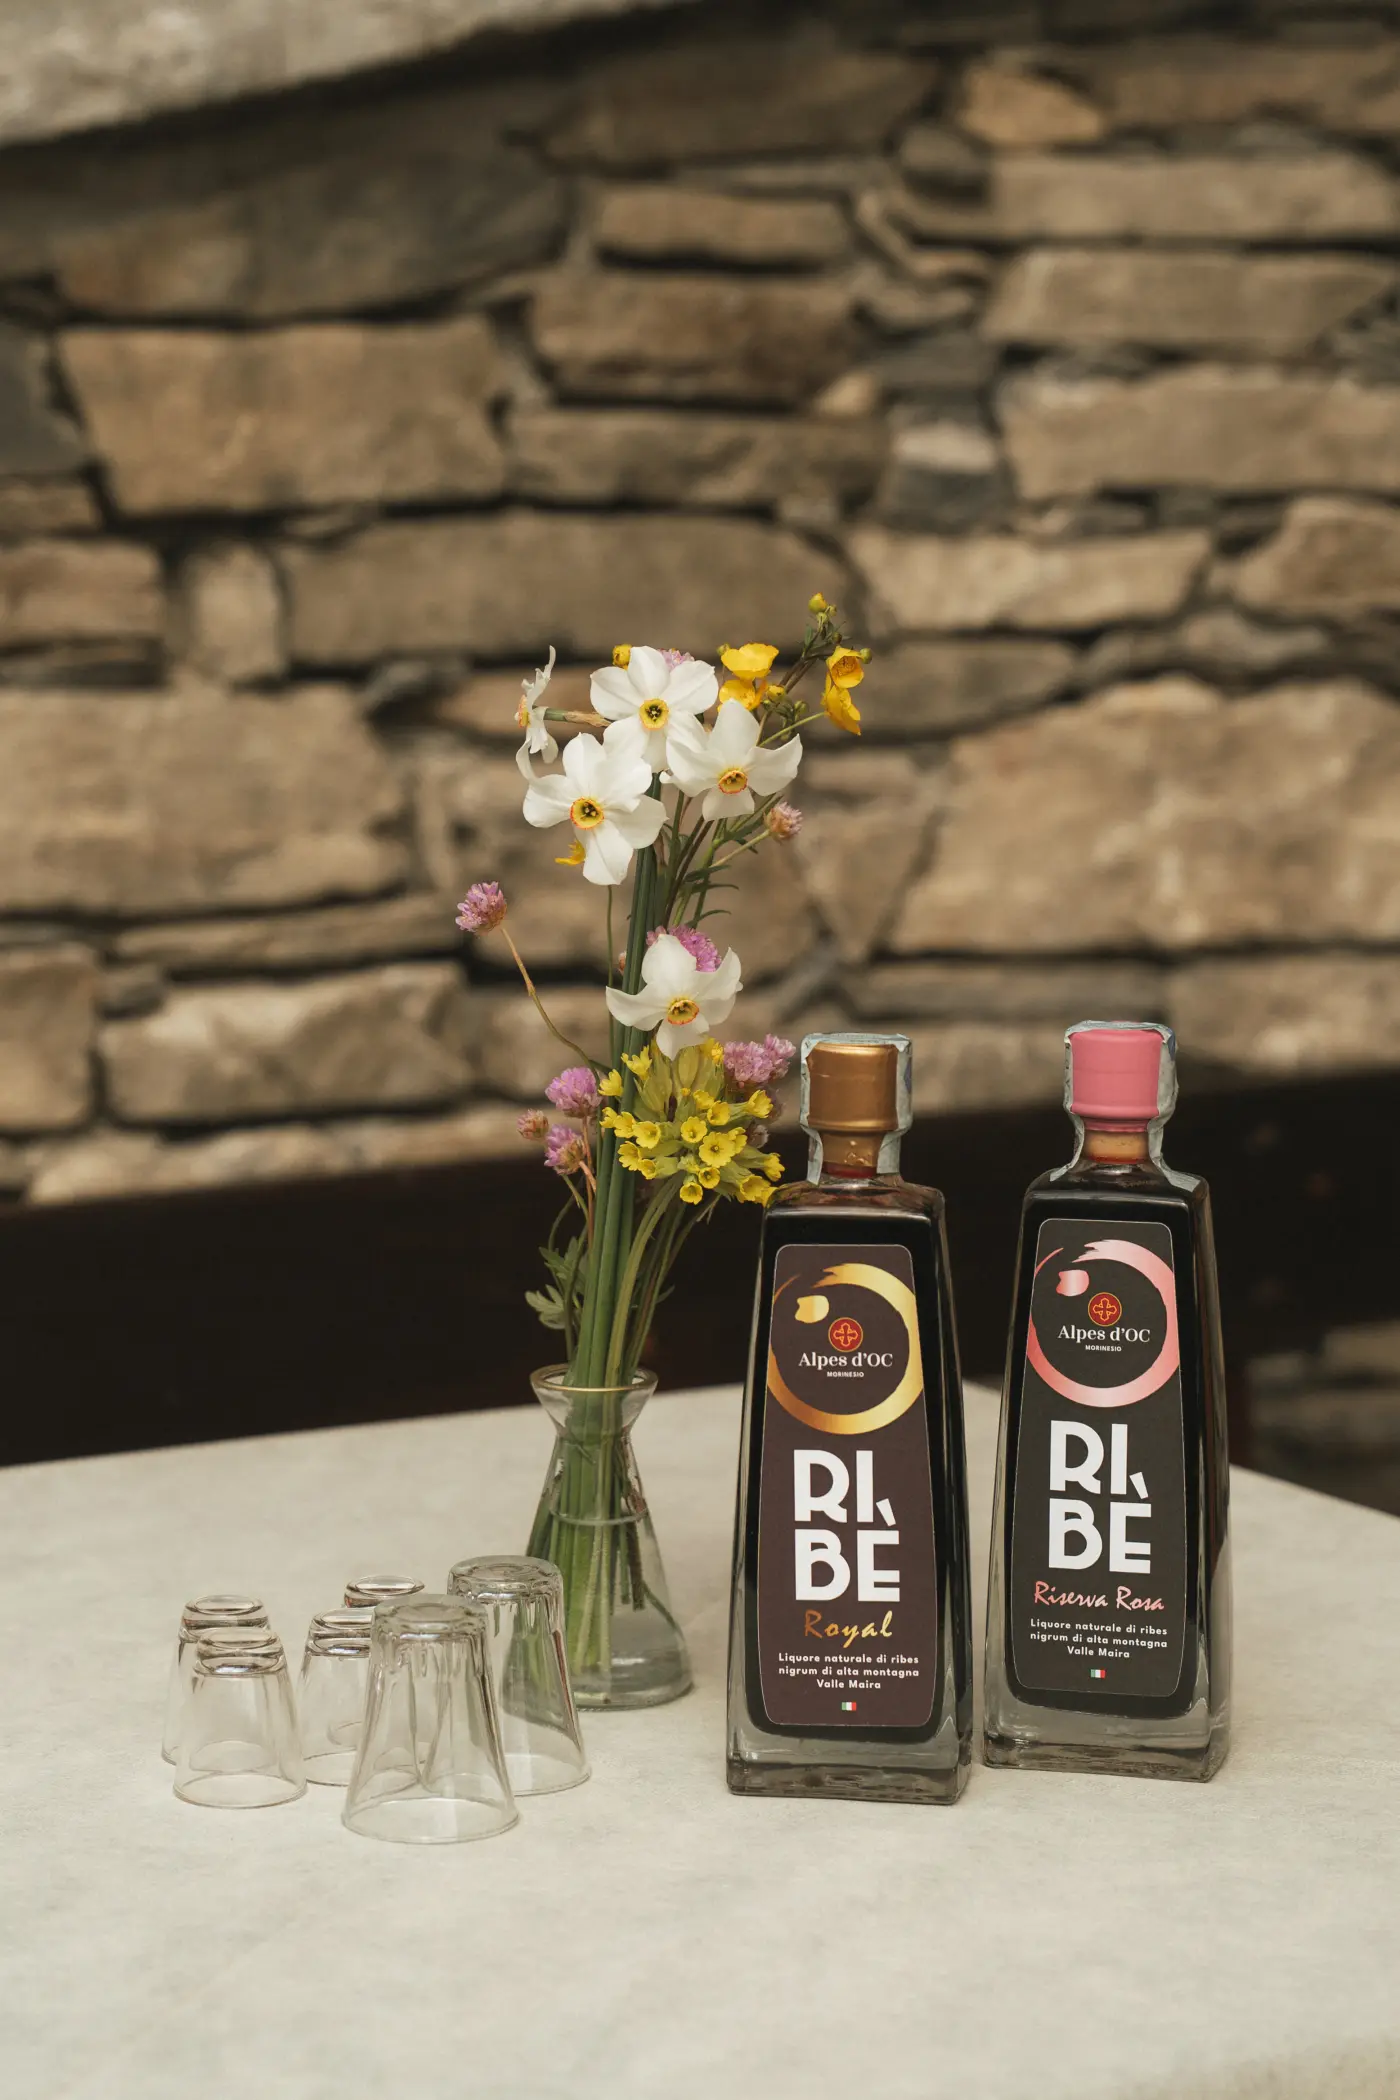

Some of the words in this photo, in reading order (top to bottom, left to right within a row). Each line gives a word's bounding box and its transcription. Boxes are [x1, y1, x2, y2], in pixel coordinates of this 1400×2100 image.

[1057, 1325, 1106, 1343] Alpes
[1085, 1344, 1122, 1352] MORINESIO
[798, 1352, 848, 1370] Alpes
[1034, 1581, 1109, 1608] Riserva
[1116, 1586, 1165, 1611] Rosa
[804, 1609, 893, 1648] Royal
[1031, 1619, 1071, 1630] Liquore
[1076, 1623, 1122, 1633] naturale
[1126, 1625, 1136, 1633] di
[1140, 1626, 1168, 1635] ribes
[1030, 1632, 1068, 1642] nigrum
[1073, 1634, 1083, 1642] di
[1087, 1635, 1109, 1644] alta
[1113, 1638, 1168, 1649] montagna
[779, 1653, 821, 1664] Liquore
[825, 1654, 872, 1664] naturale
[876, 1654, 887, 1664] di
[891, 1655, 919, 1664] ribes
[1067, 1646, 1094, 1656] Valle
[1099, 1648, 1130, 1658] Maira
[779, 1666, 818, 1677] nigrum
[822, 1667, 833, 1675] di
[837, 1667, 859, 1676] alta
[864, 1668, 919, 1679] montagna
[817, 1679, 845, 1689] Valle
[849, 1680, 881, 1689] Maira
